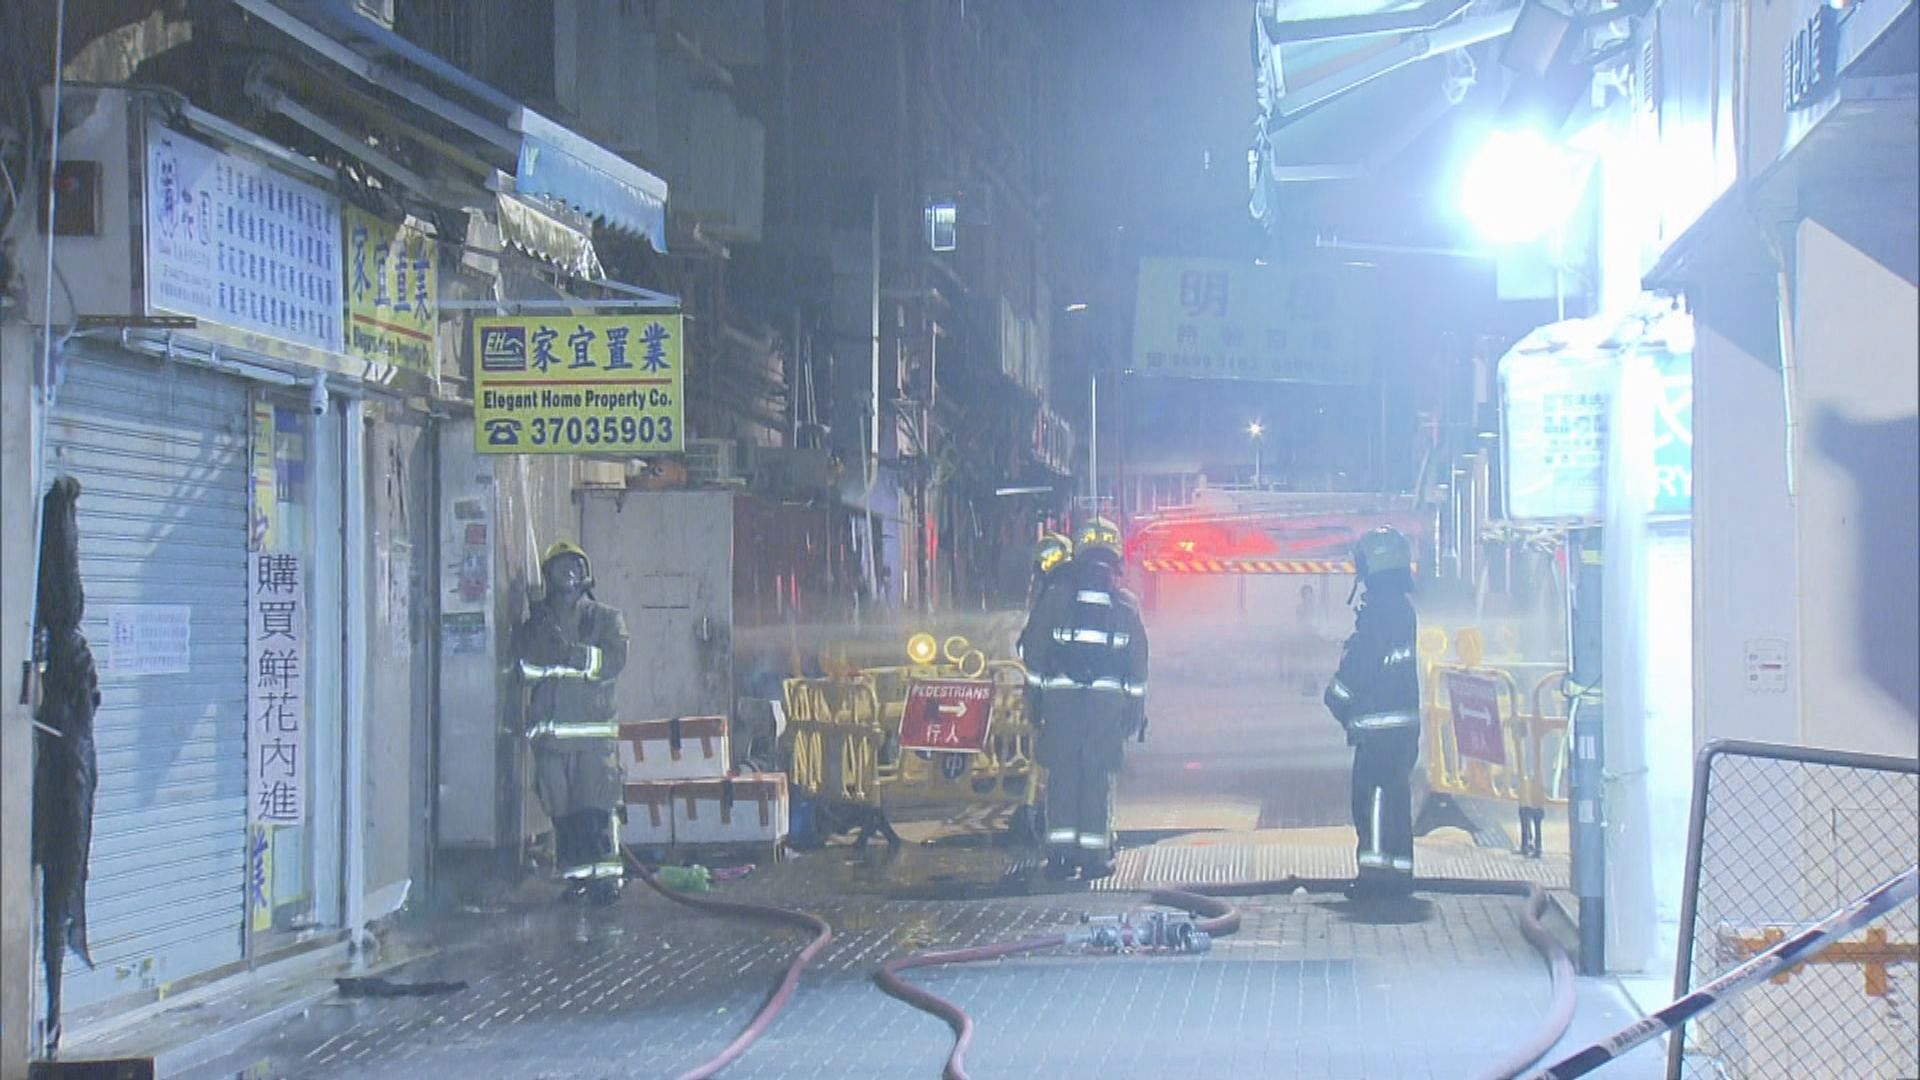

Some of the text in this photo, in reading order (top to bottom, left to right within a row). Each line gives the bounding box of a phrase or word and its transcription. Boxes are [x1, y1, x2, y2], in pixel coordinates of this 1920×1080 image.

[531, 321, 672, 373] 家宜置業
[483, 388, 672, 411] Elegant Home Property Co.
[531, 416, 673, 445] 37035903
[926, 722, 959, 744] 行人
